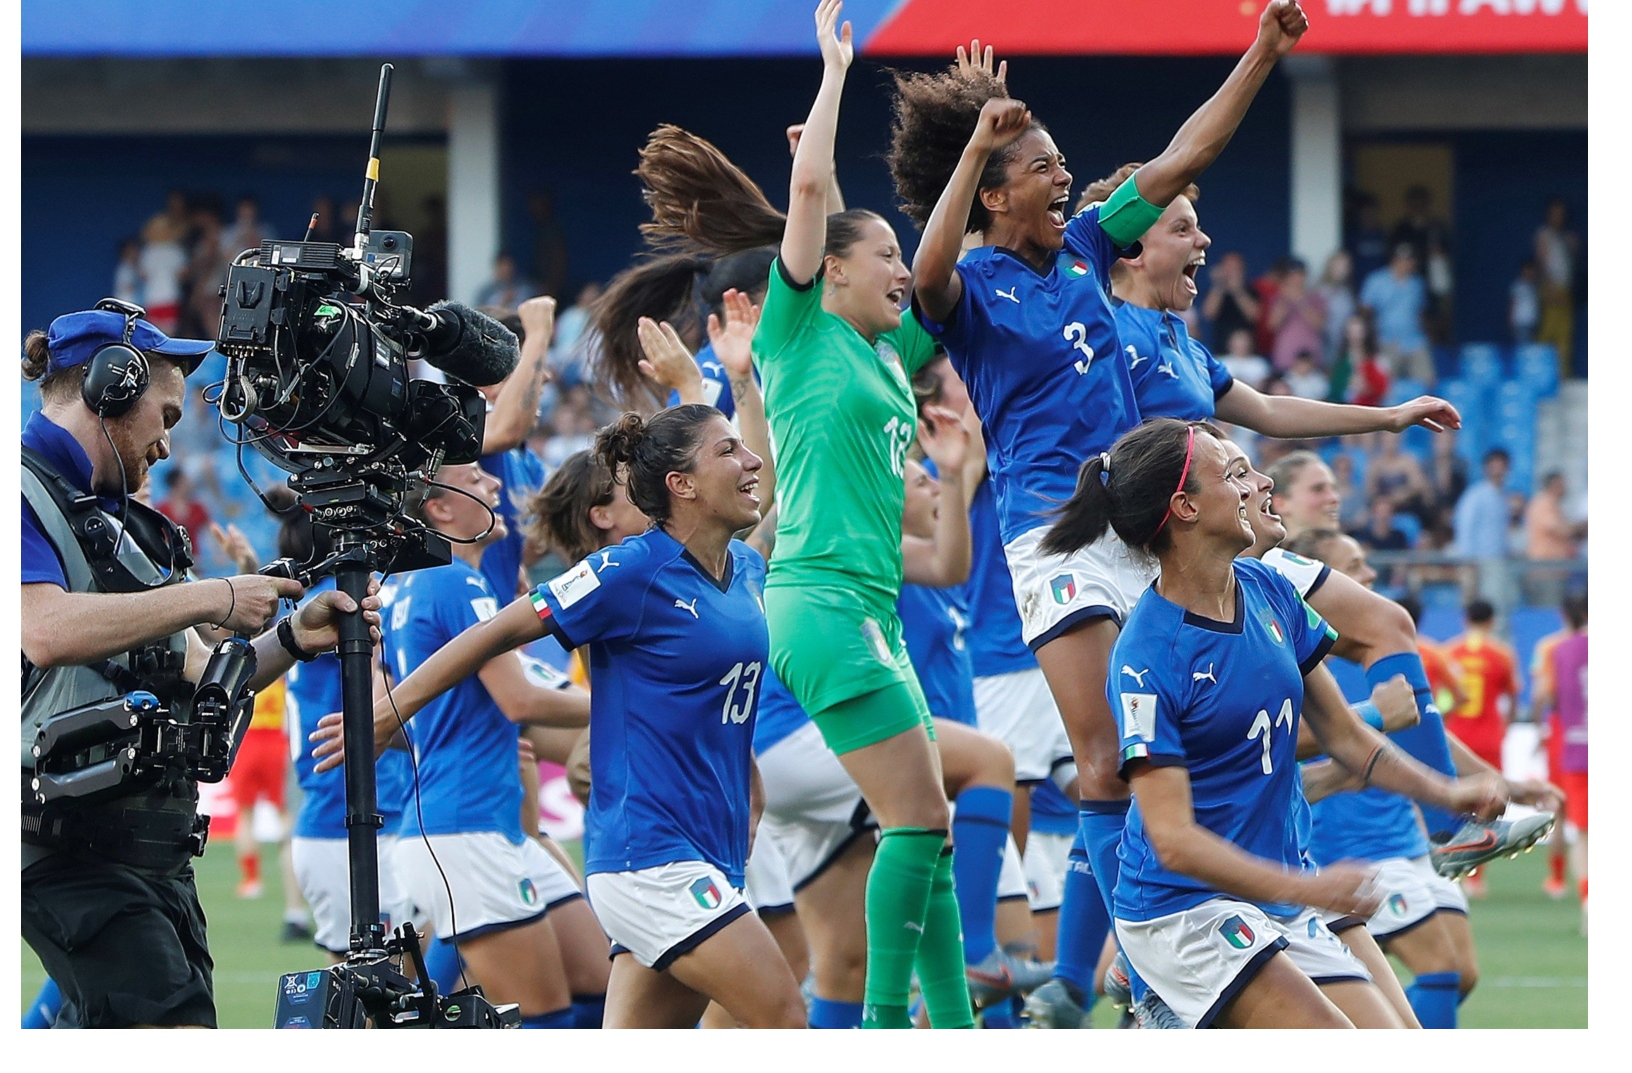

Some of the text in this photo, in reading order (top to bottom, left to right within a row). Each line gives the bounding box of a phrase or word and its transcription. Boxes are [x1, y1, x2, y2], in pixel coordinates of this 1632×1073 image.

[1062, 321, 1095, 376] 3
[719, 661, 762, 725] 13
[1246, 697, 1294, 775] 11
